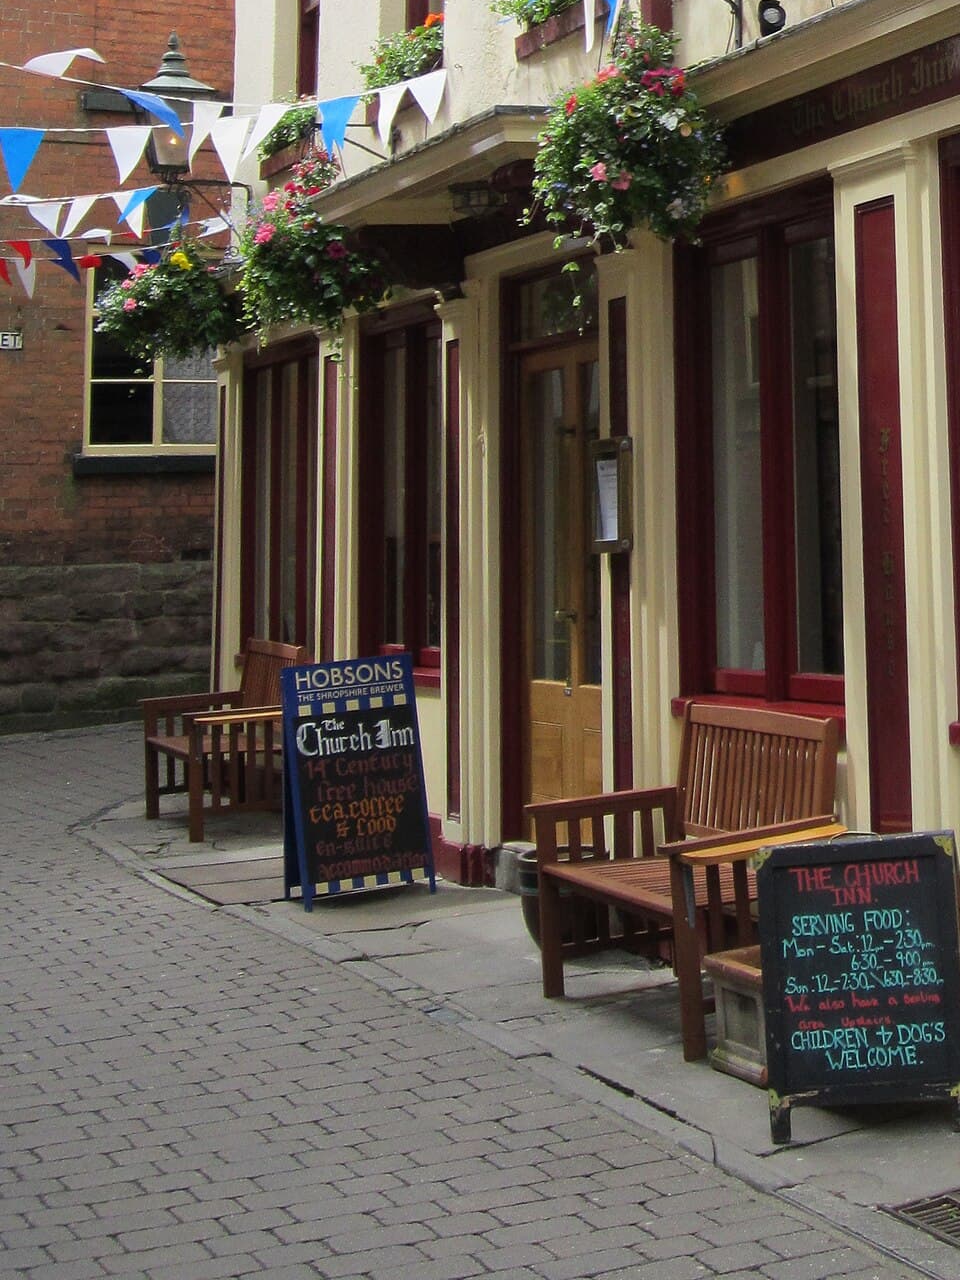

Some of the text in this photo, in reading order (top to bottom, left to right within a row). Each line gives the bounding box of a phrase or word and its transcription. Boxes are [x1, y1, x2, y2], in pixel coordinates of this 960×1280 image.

[831, 65, 903, 121] Church
[295, 661, 404, 690] HOBSONS
[298, 683, 404, 703] THE SHROPSHIRE BREWER
[296, 719, 415, 756] Church Inn
[320, 718, 345, 731] The
[357, 815, 397, 836] food
[789, 860, 919, 892] THE CHURCH
[792, 909, 910, 936] SERVING FOOD:
[782, 939, 814, 958] Mon
[785, 995, 810, 1012] We
[819, 997, 845, 1010] also
[852, 992, 880, 1008] have
[888, 996, 898, 1006] a
[791, 1027, 869, 1051] CHILDREN
[897, 1022, 946, 1045] DOG'S
[825, 1045, 924, 1070] WELCOME.
